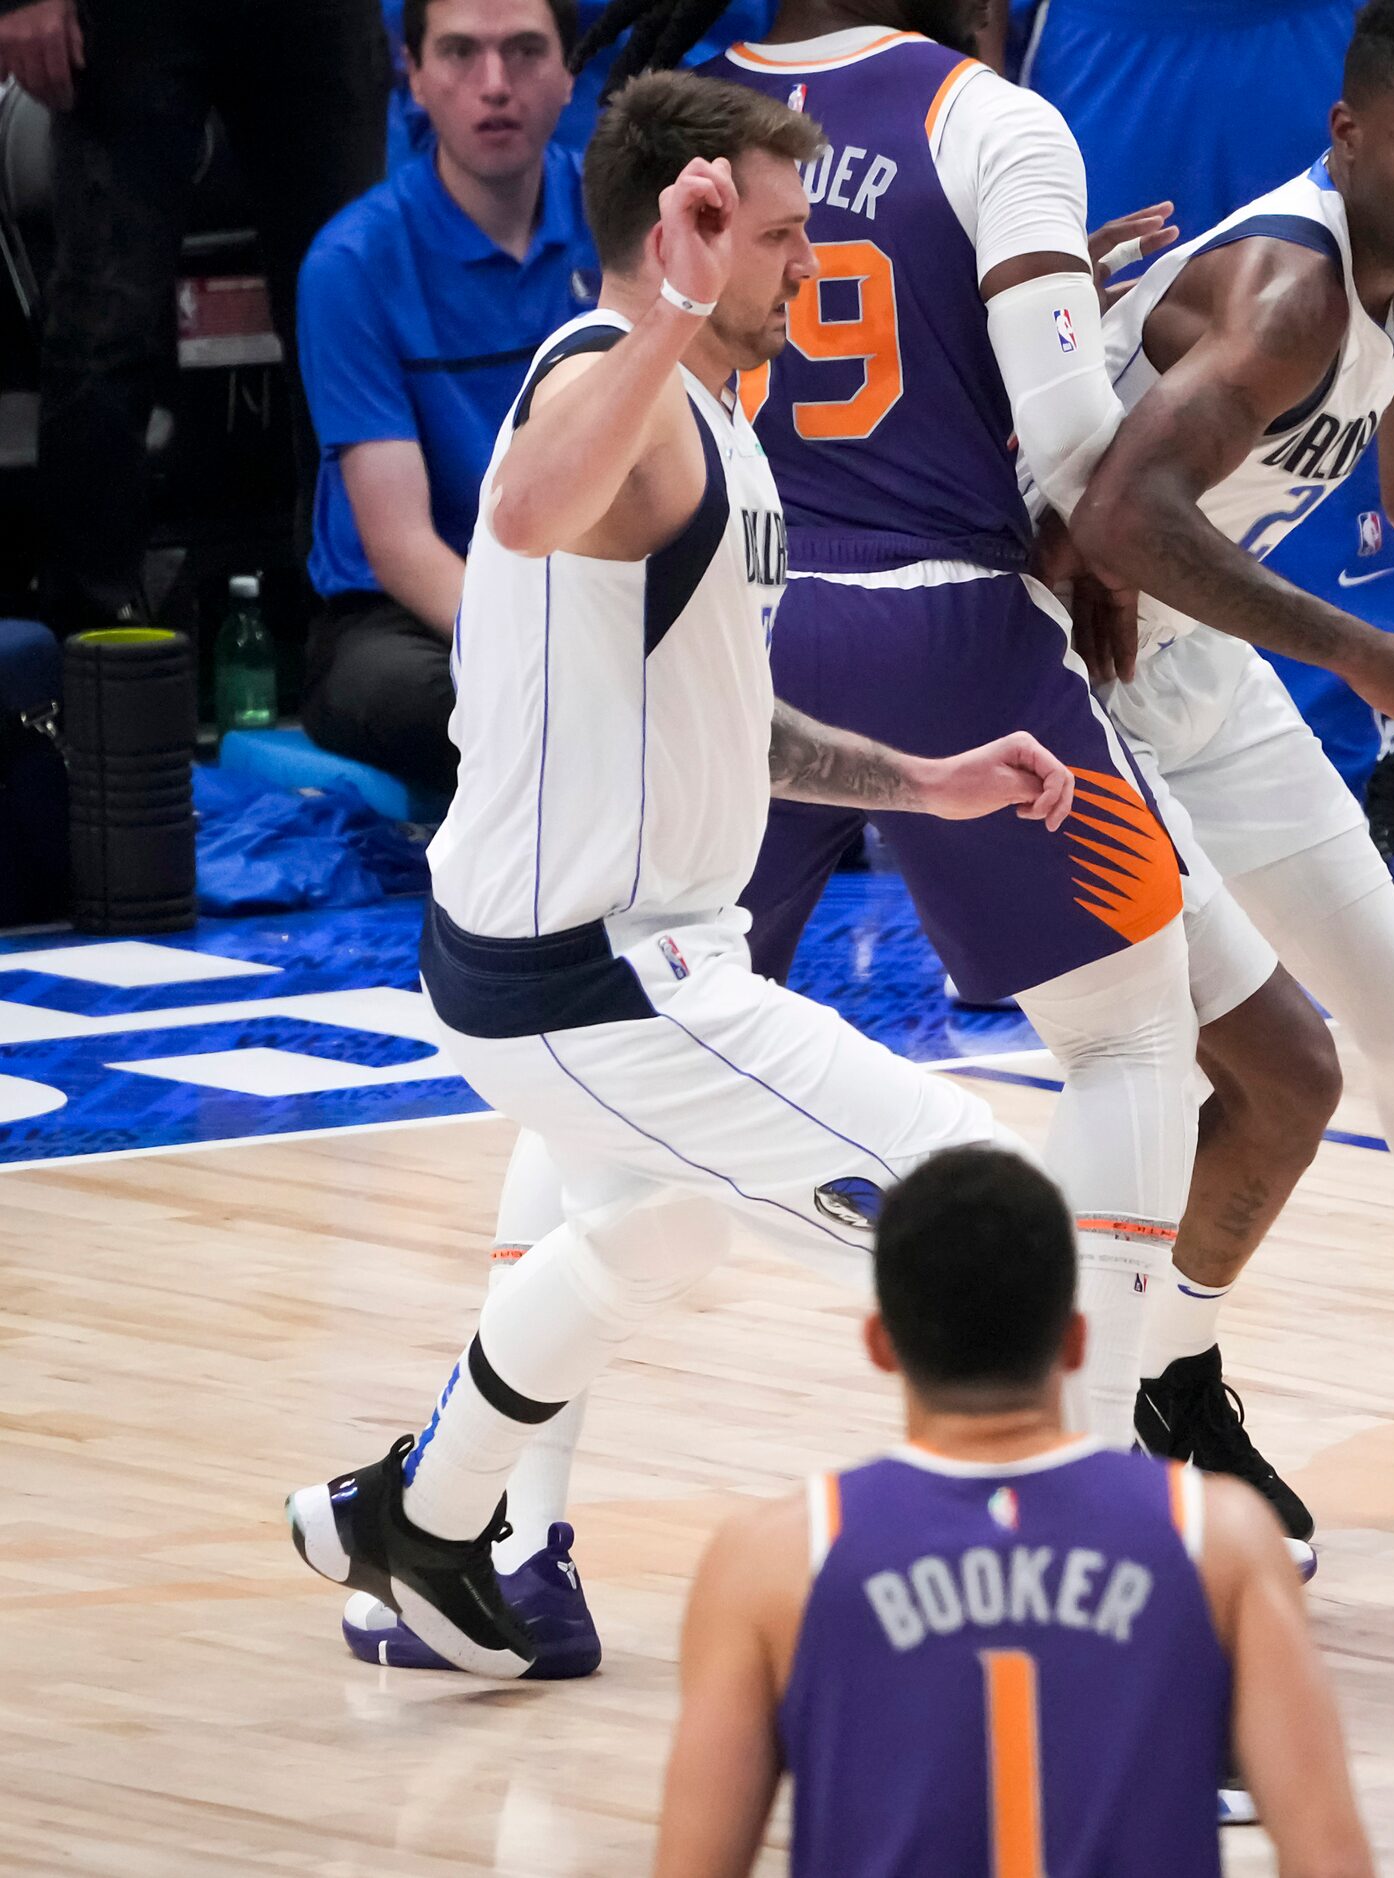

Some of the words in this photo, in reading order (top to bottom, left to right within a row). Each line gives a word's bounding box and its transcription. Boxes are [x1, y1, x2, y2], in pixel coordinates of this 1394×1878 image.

[795, 144, 898, 220] DER
[862, 1545, 1154, 1652] BOOKER
[975, 1647, 1045, 1878] 1
